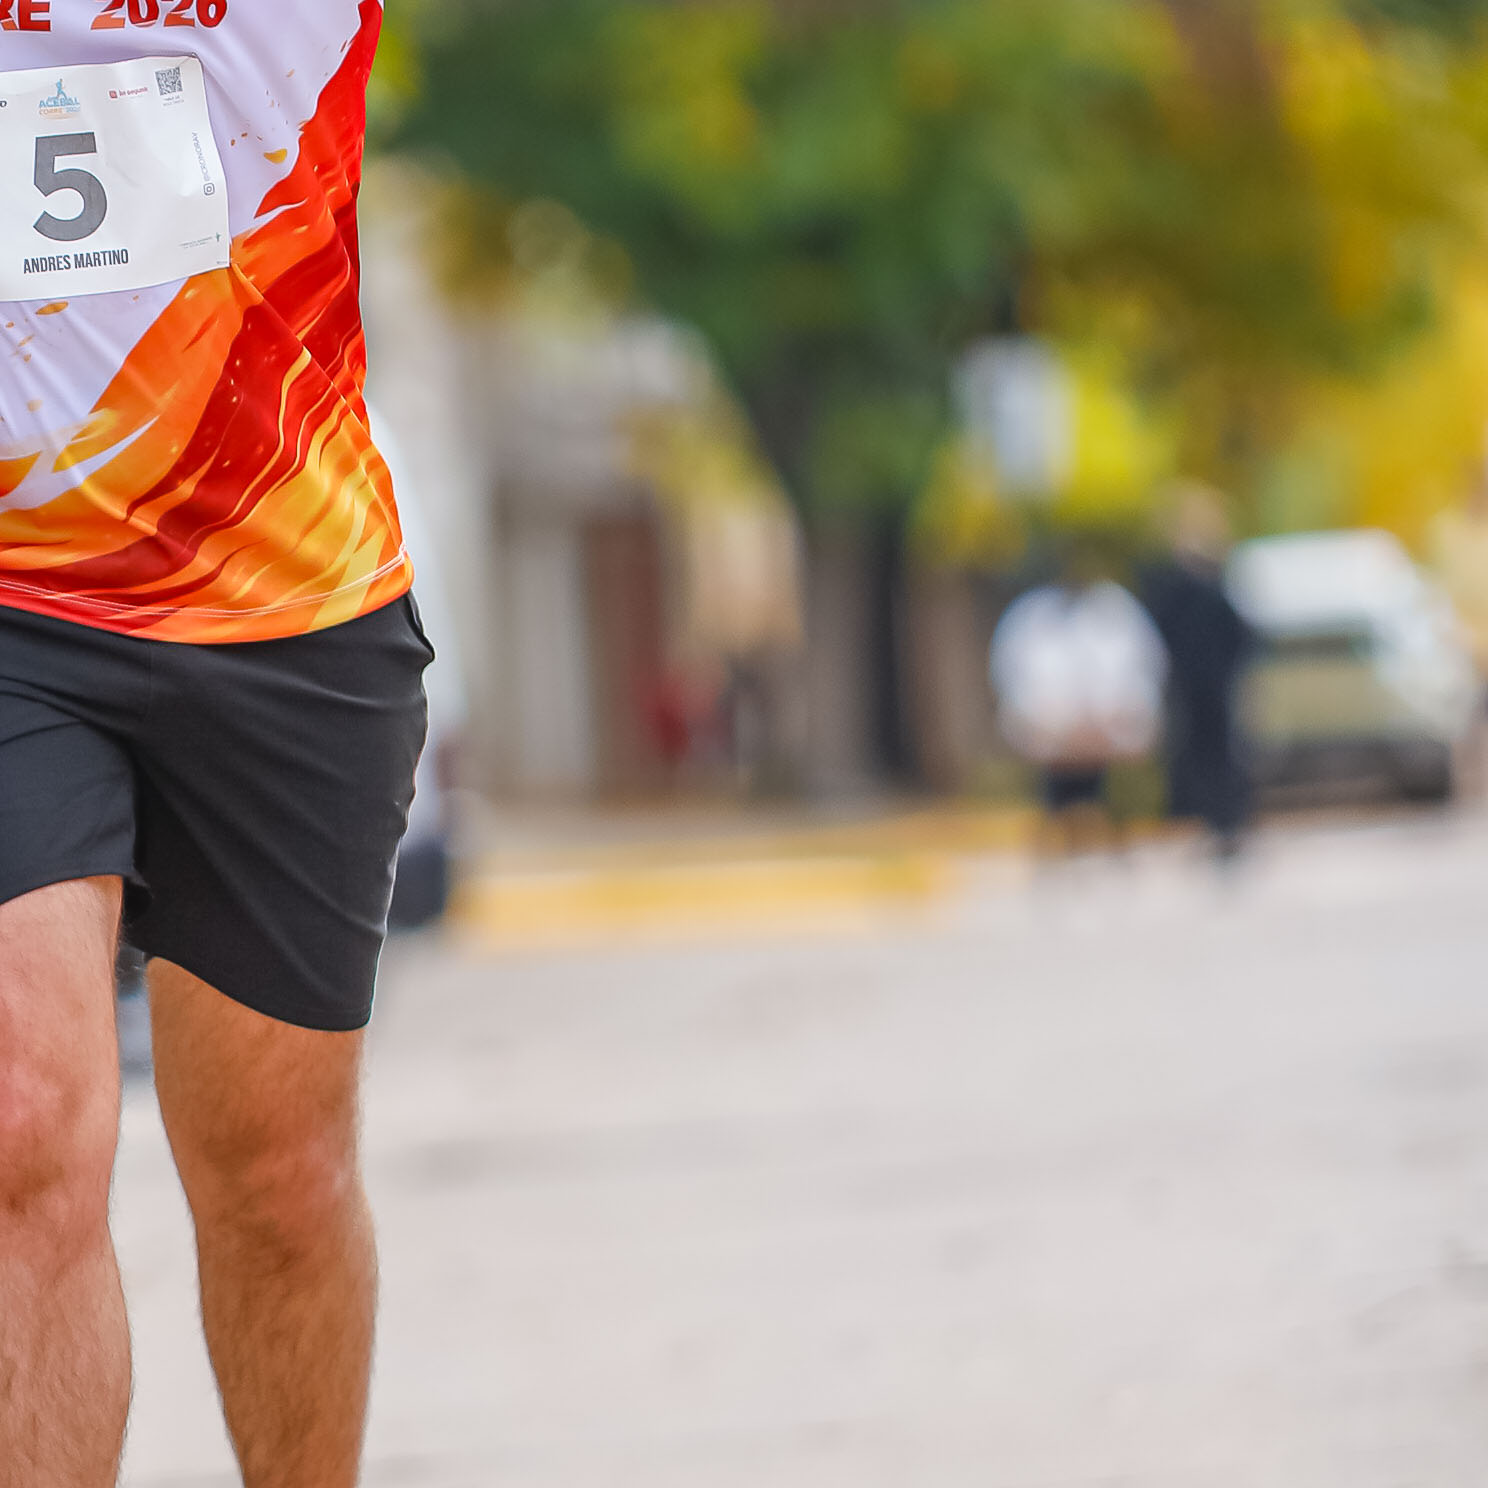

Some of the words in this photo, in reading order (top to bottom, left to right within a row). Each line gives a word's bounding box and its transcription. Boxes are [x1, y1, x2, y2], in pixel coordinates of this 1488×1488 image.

[32, 131, 107, 242] 5
[23, 254, 72, 274] ANDRES
[73, 248, 129, 269] MARTINO
